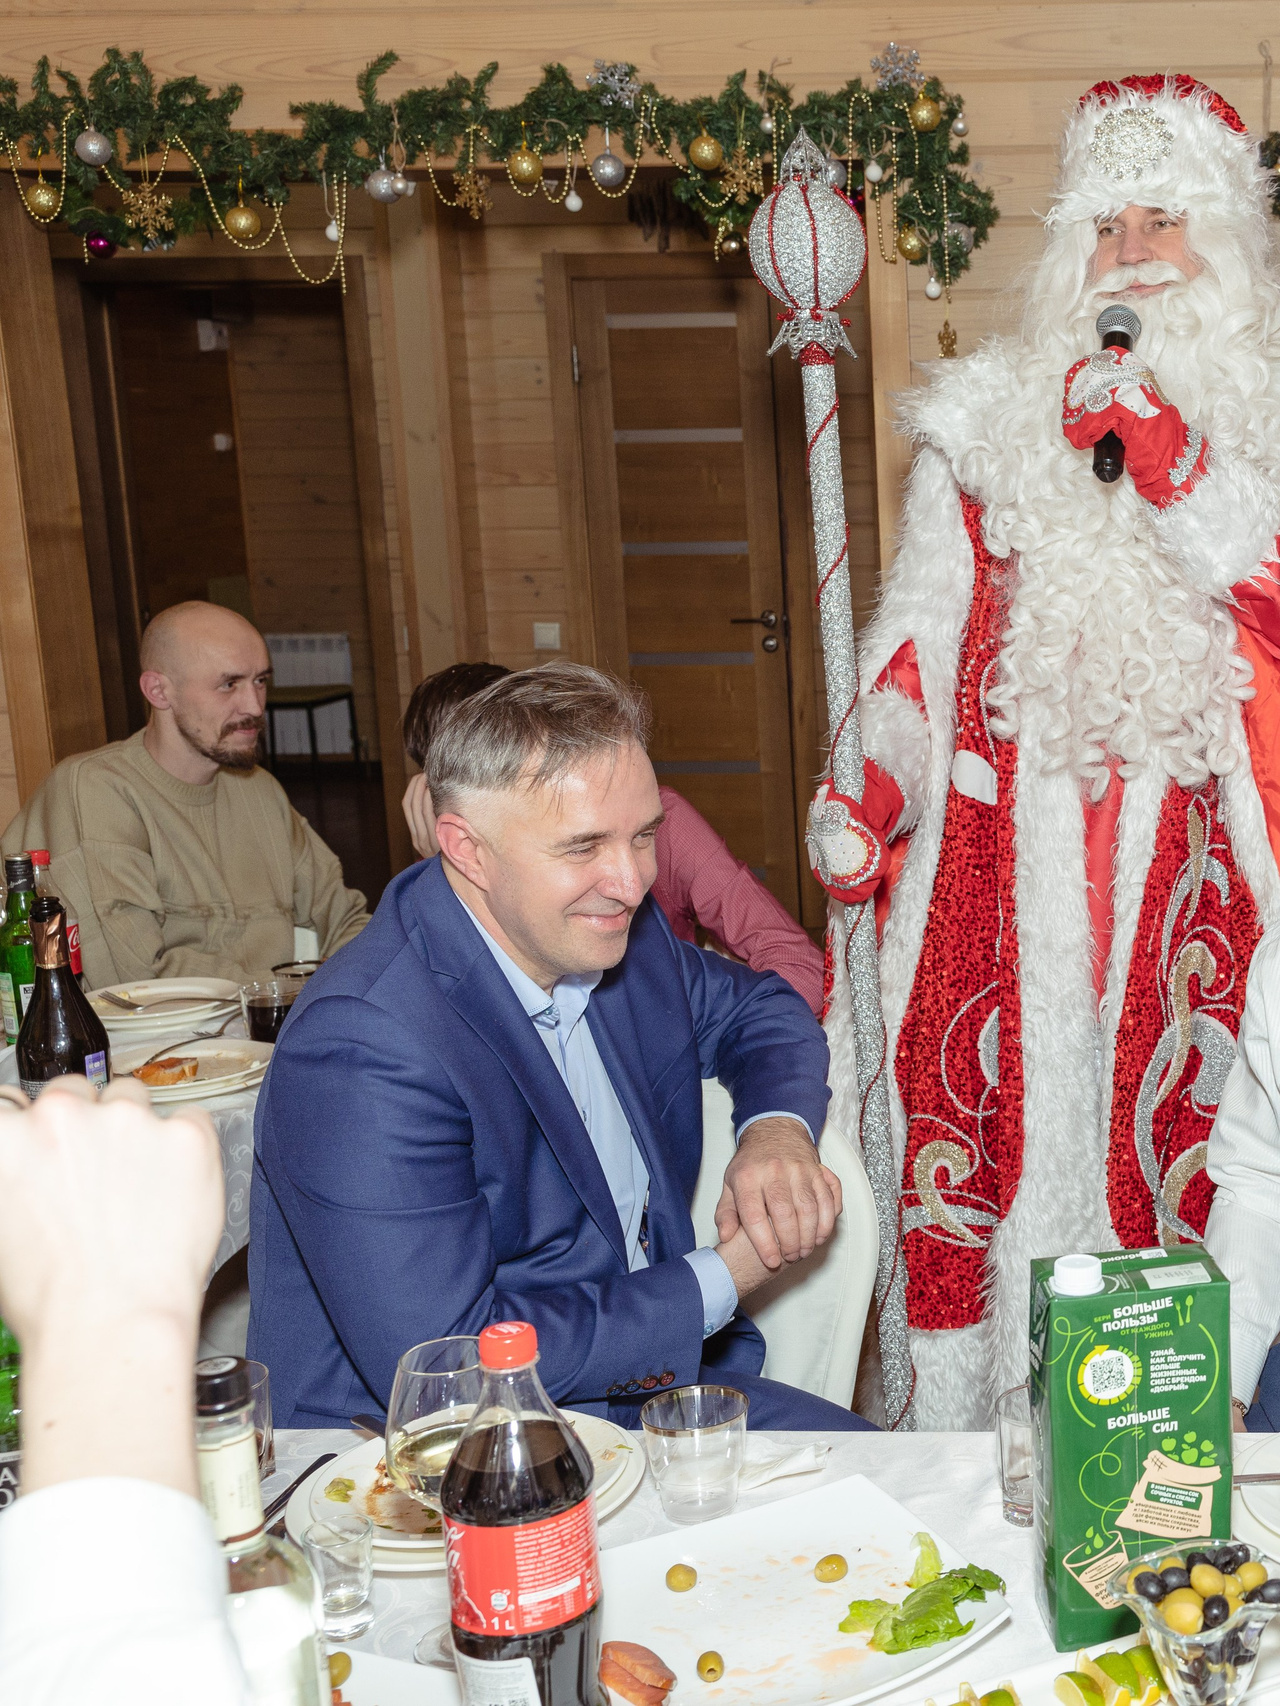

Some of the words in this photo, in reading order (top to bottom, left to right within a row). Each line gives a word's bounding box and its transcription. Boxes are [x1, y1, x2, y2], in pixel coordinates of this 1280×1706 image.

[1094, 1314, 1111, 1323] БЕРИ
[1112, 1296, 1174, 1319] БОЛЬШЕ
[1102, 1312, 1158, 1332] ПОЛЬЗЫ
[1144, 1330, 1174, 1340] УЖИНА
[1167, 1353, 1206, 1363] ПОЛУЧИТЬ
[1150, 1362, 1181, 1371] БОЛЬШЕ
[1150, 1368, 1198, 1378] ЖИЗНЕННЫХ
[1172, 1375, 1207, 1383] БРЕНДОМ
[1107, 1406, 1171, 1430] БОЛЬШЕ
[1152, 1421, 1178, 1434] СИЛ
[491, 1617, 499, 1630] 1
[505, 1620, 515, 1630] L
